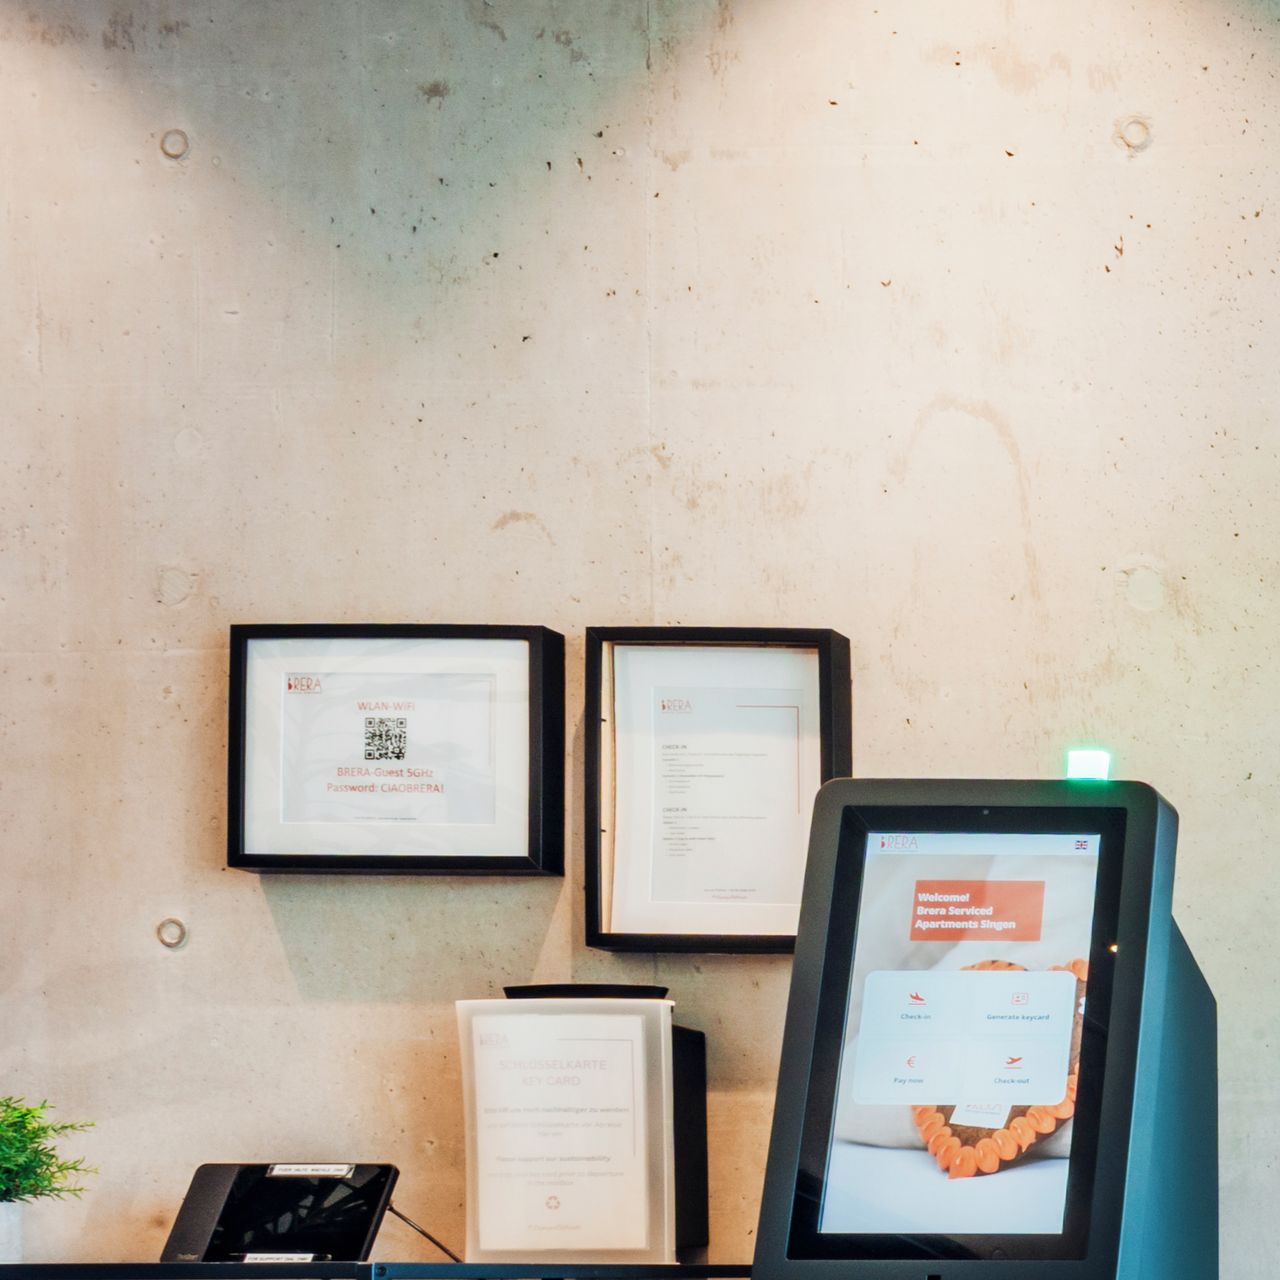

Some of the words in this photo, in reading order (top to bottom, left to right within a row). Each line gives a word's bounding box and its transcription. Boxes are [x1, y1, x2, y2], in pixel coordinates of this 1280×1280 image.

[337, 768, 404, 779] BRERA-Guest
[406, 768, 434, 779] 5GHz
[327, 783, 377, 793] Password:
[918, 893, 970, 903] Welcome!
[916, 906, 947, 916] Brera
[948, 906, 994, 916] Serviced
[914, 919, 979, 931] Apartments
[980, 919, 1017, 931] Singen
[900, 1013, 932, 1021] Check-in
[546, 1076, 582, 1086] CARD
